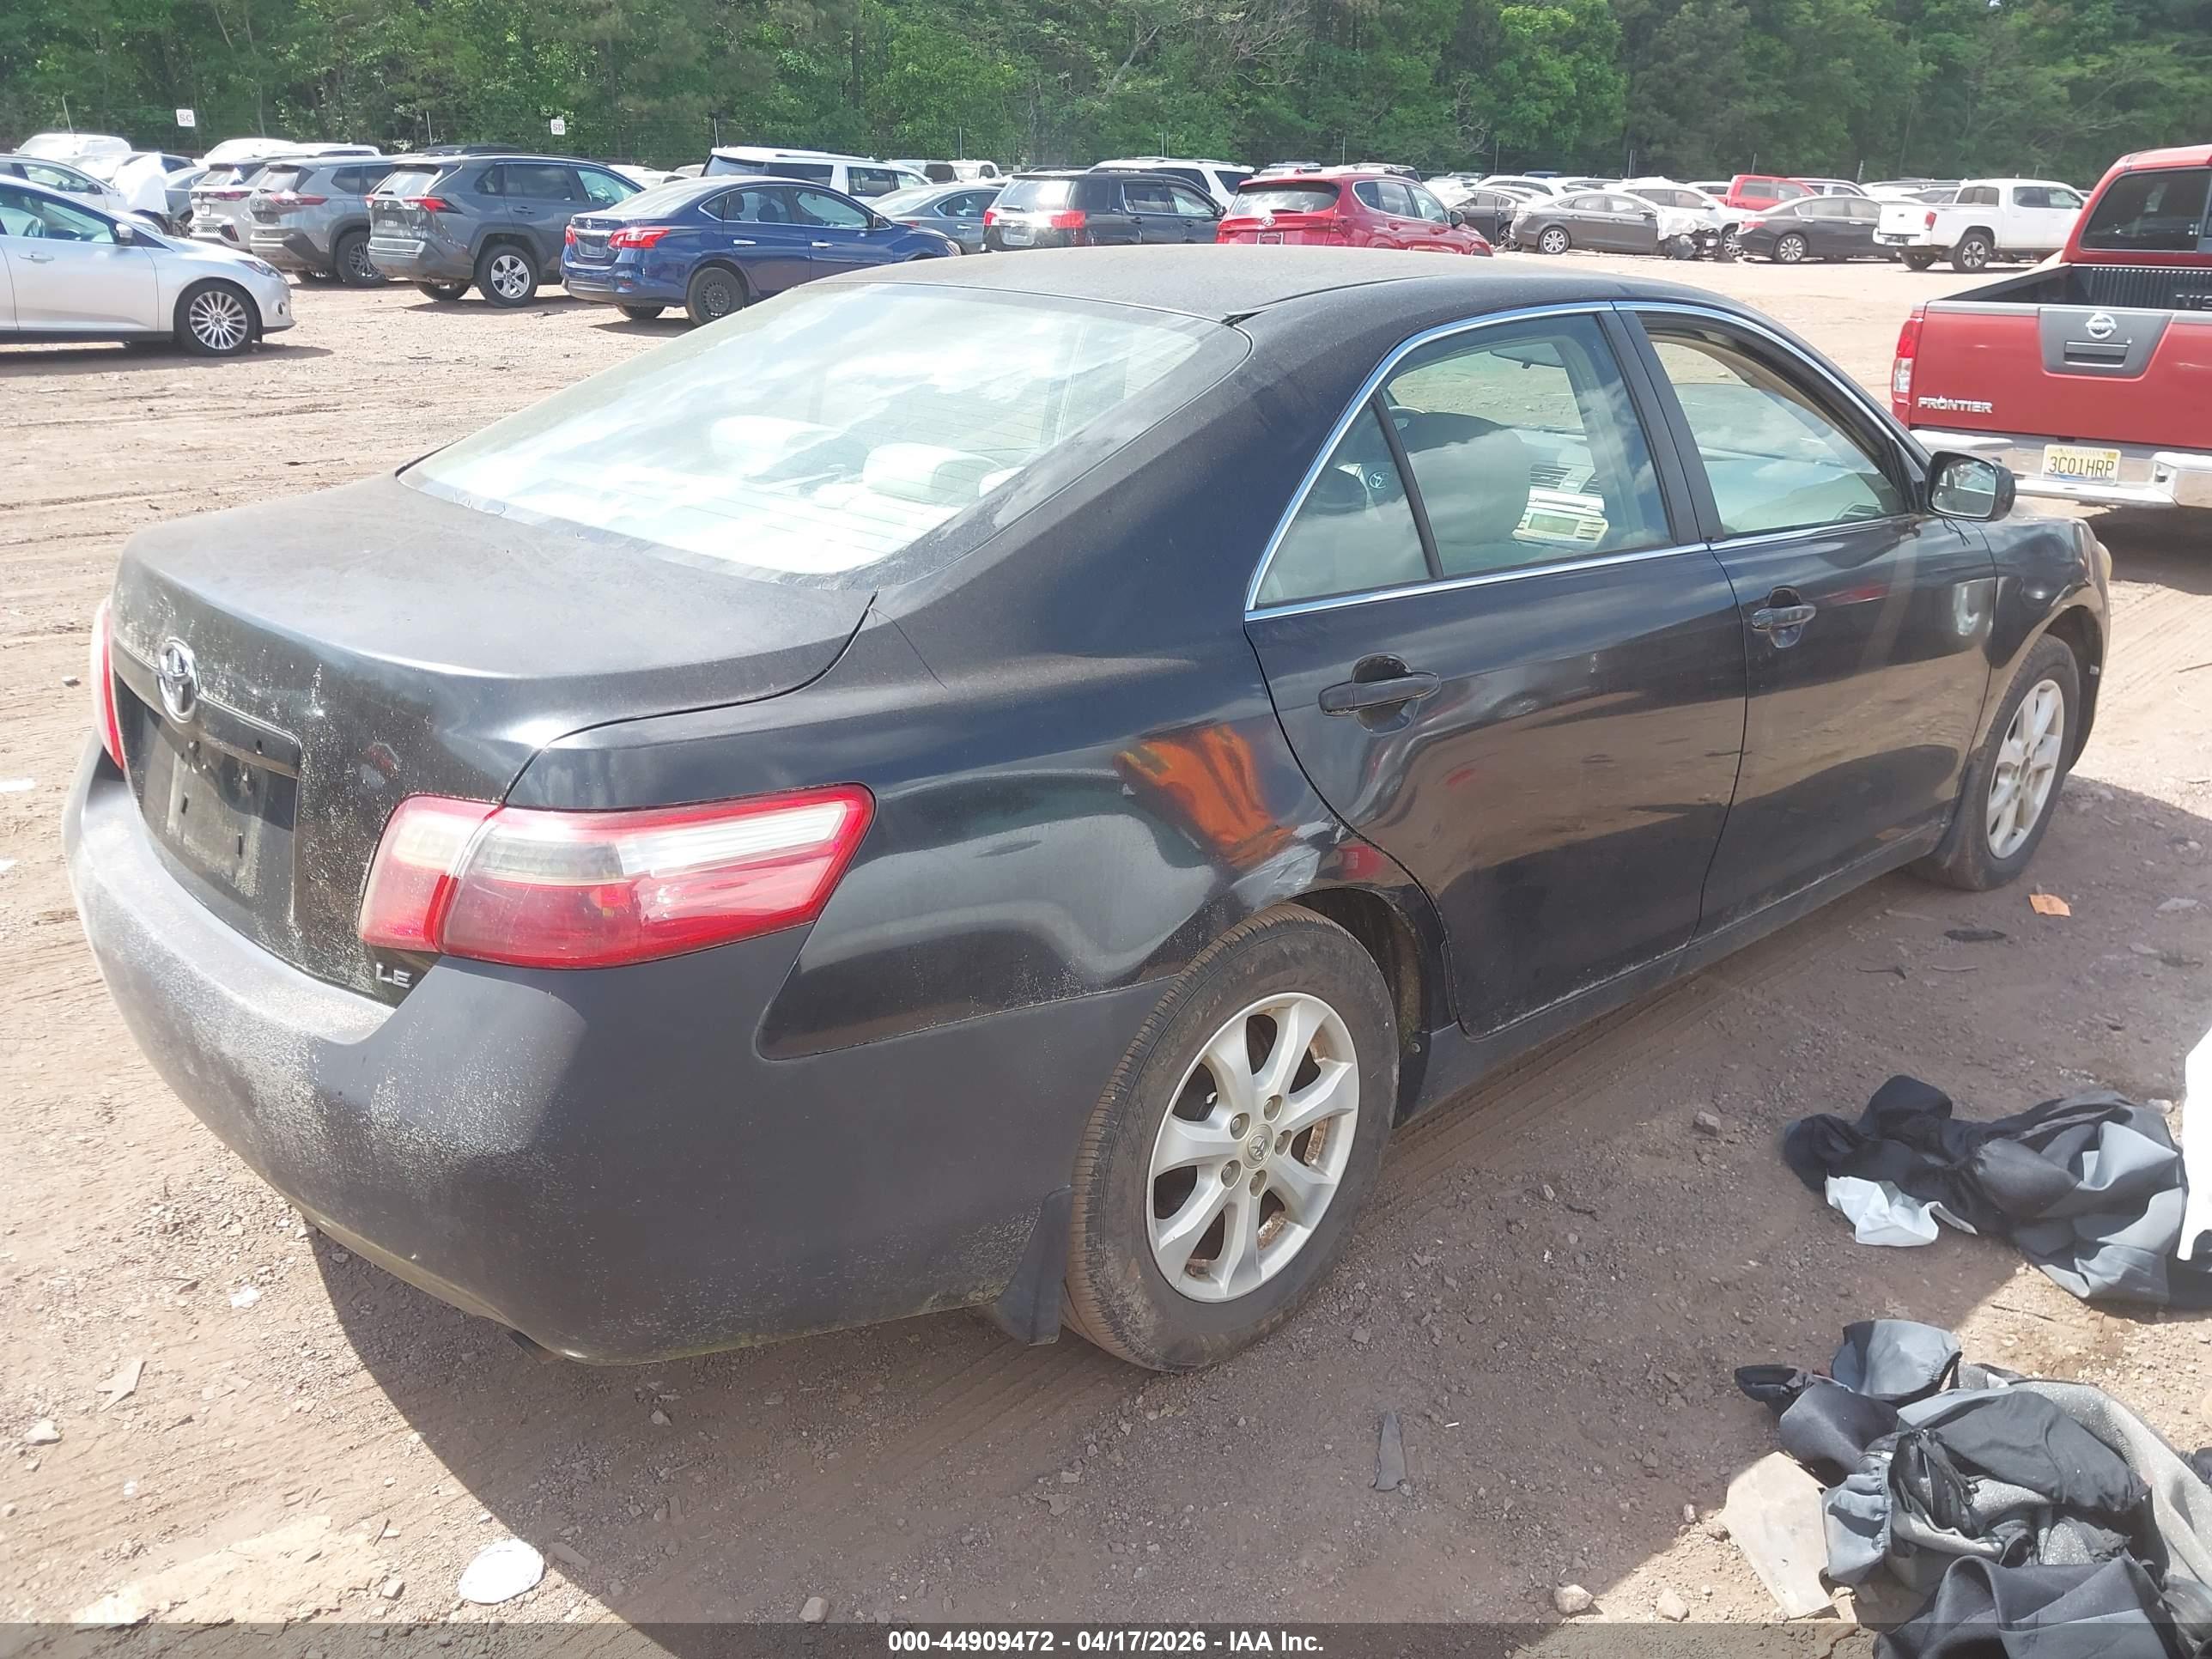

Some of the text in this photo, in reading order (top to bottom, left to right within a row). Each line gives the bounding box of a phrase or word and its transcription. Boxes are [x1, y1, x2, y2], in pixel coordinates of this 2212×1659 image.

[1917, 395, 1993, 414] FRONTIER
[2048, 456, 2115, 477] 3C01HRP
[375, 962, 412, 989] LE
